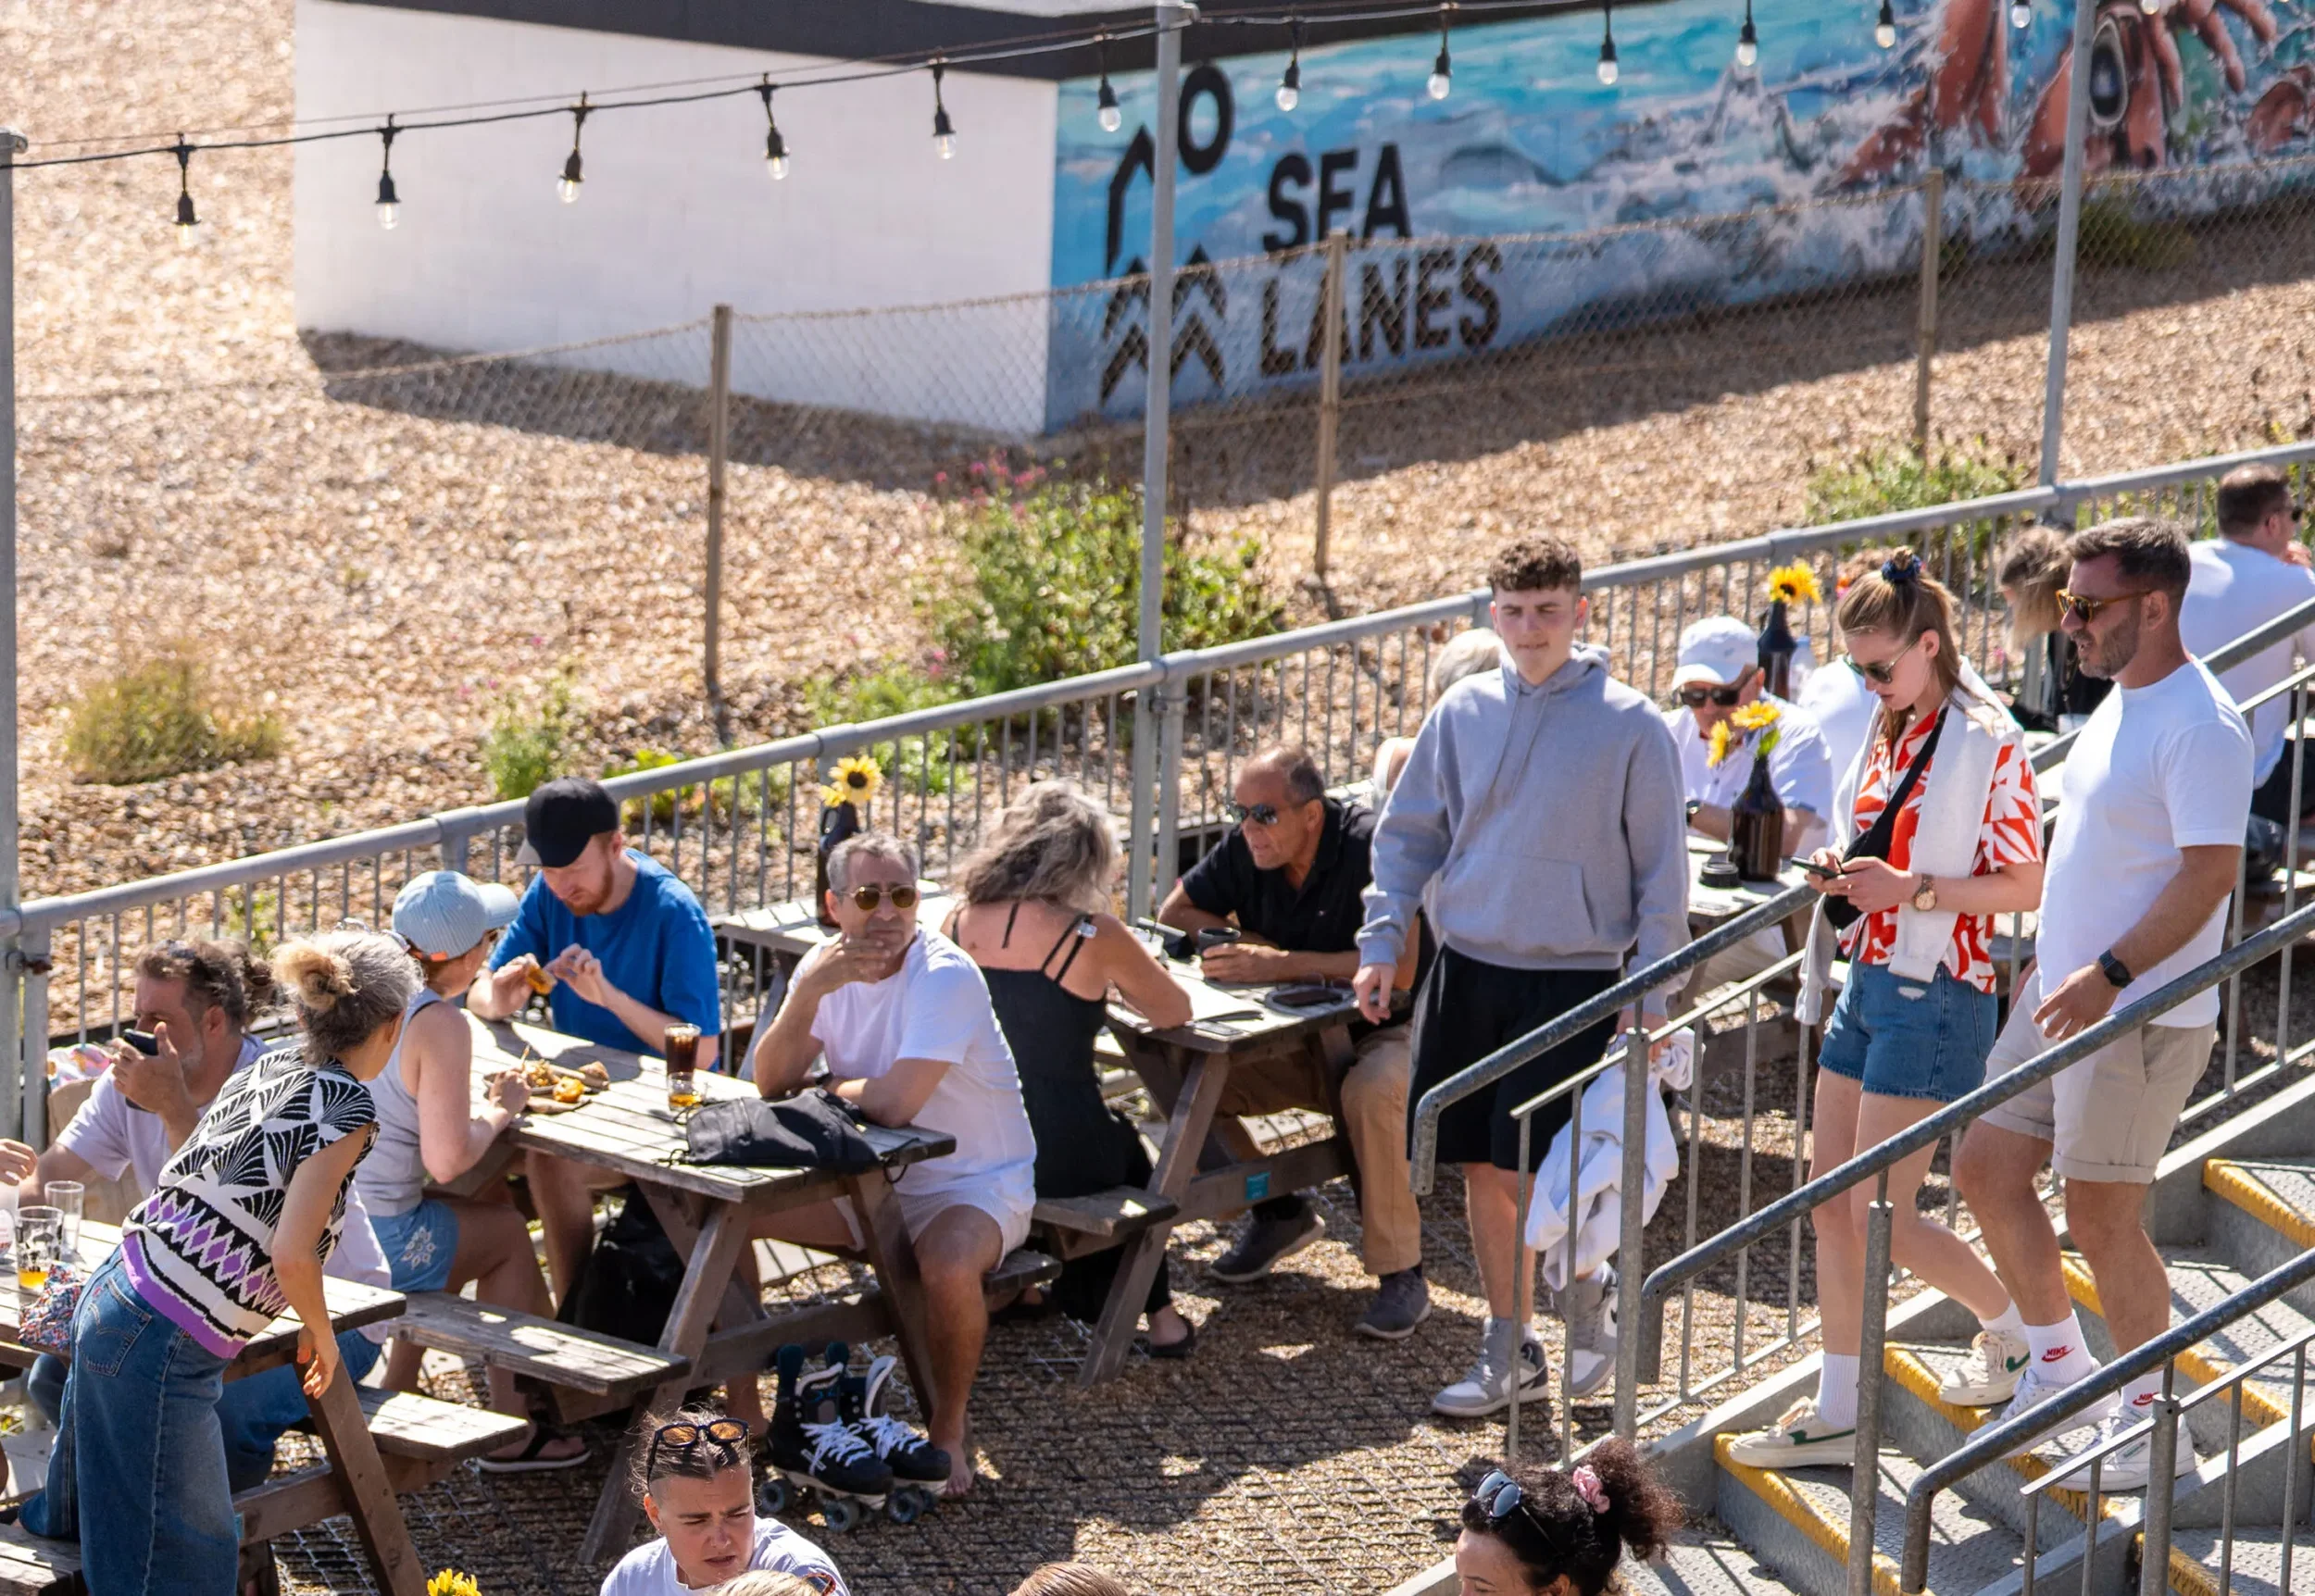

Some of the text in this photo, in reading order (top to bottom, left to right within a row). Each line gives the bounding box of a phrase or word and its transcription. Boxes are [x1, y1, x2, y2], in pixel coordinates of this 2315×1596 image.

[1263, 142, 1413, 260] SEA
[1260, 242, 1503, 377] LANES
[2046, 1344, 2068, 1357] NIKE
